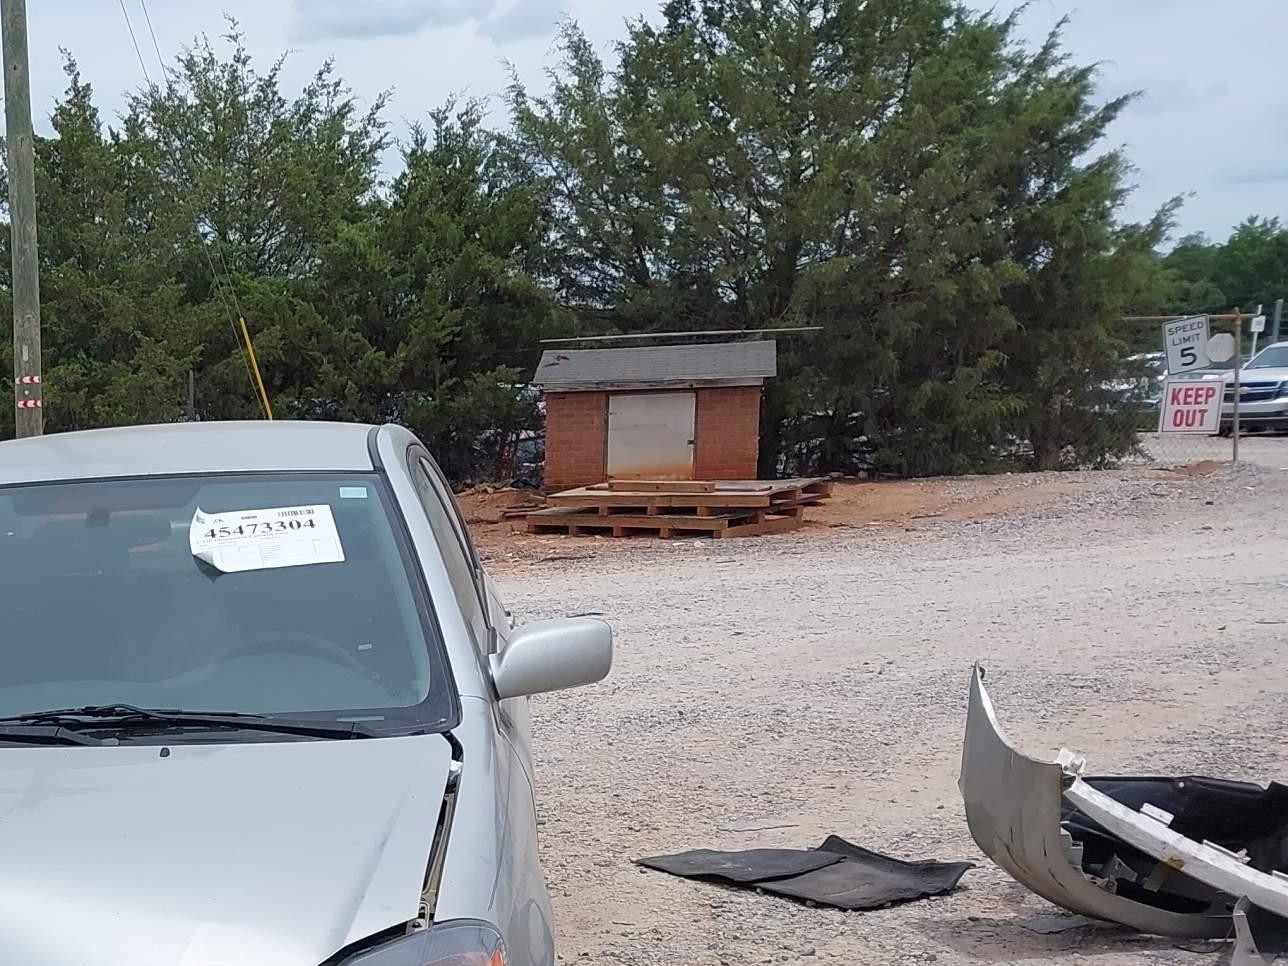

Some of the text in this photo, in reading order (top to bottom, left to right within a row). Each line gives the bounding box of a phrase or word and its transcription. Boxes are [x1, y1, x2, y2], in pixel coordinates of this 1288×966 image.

[1167, 320, 1204, 336] SPEED
[1172, 333, 1201, 346] LIMIT
[1180, 346, 1197, 366] 5
[1170, 387, 1217, 406] KEEP
[1172, 409, 1209, 427] OUT
[204, 518, 316, 539] 45473304
